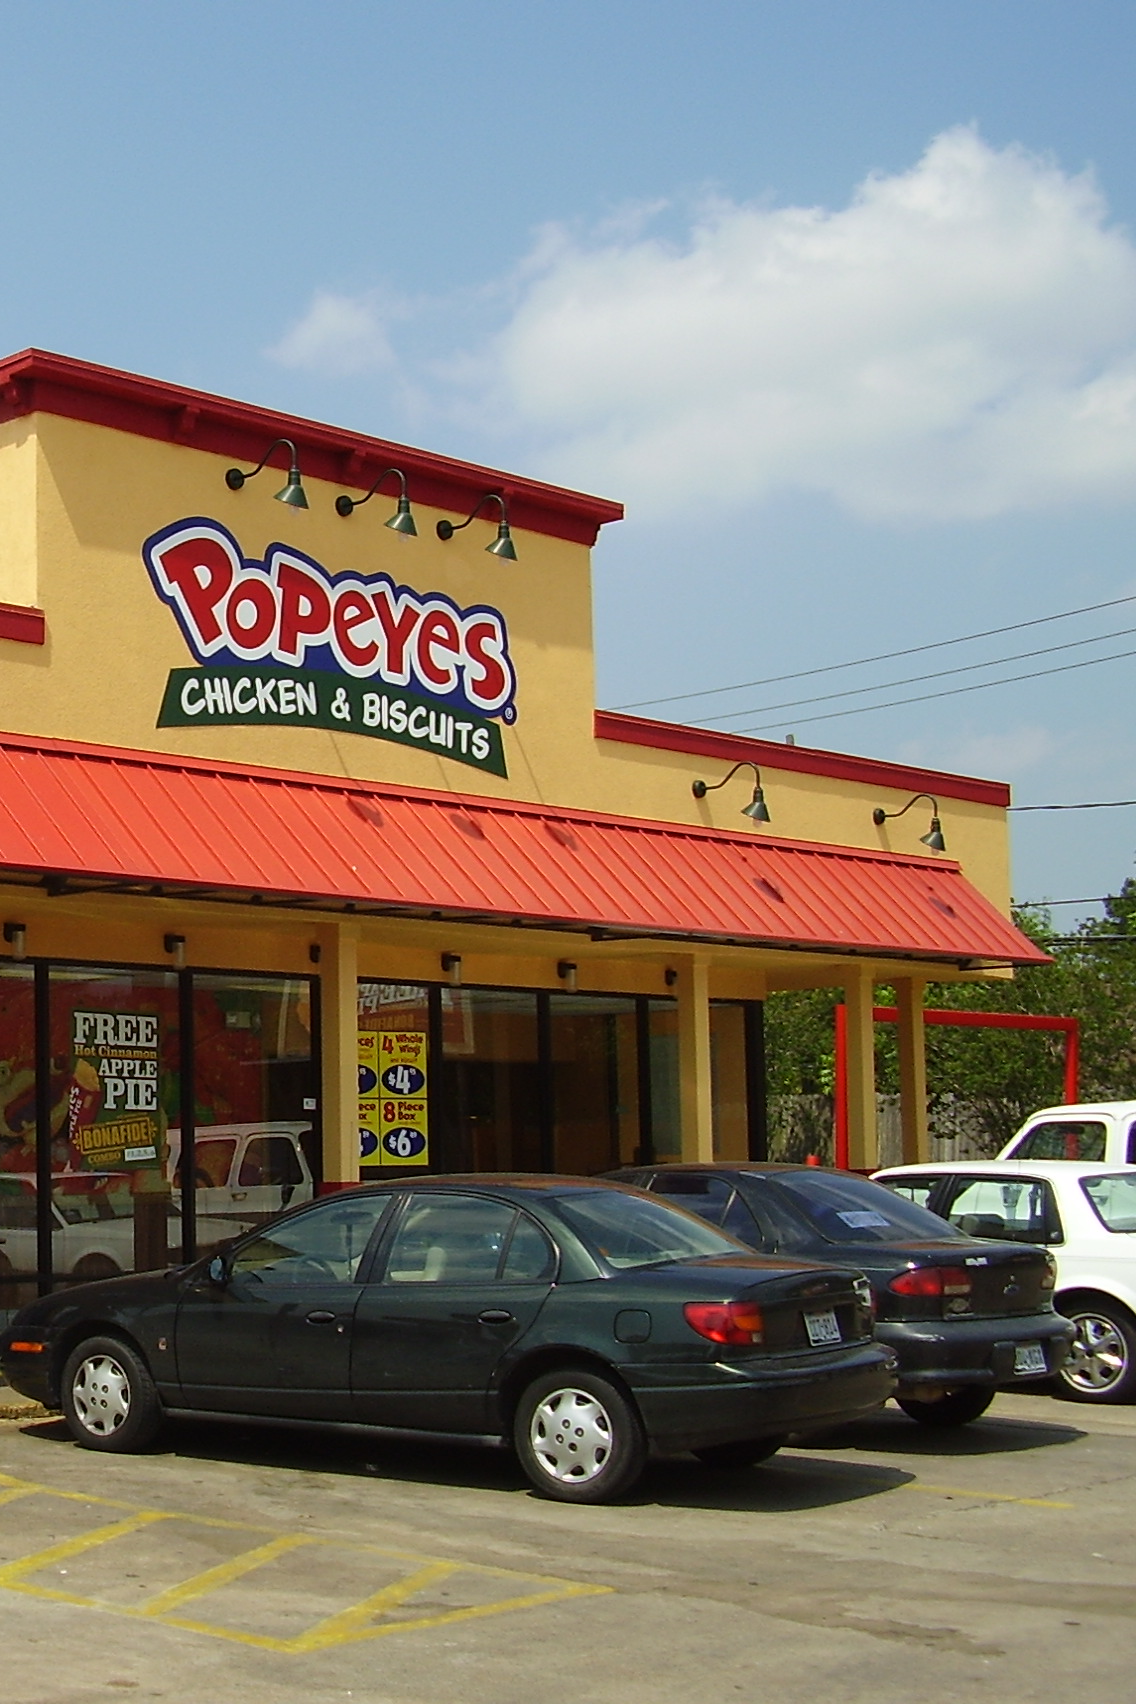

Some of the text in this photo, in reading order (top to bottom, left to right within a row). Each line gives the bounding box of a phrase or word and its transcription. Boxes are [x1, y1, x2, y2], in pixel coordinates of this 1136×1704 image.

[180, 677, 490, 760] CHICKEN & BISCUITS
[73, 1011, 158, 1048] FREE
[74, 1044, 158, 1060] Hot Cinnamon
[382, 1035, 394, 1055] 4
[98, 1058, 157, 1078] APPLE
[104, 1077, 157, 1111] PIE
[384, 1101, 424, 1122] 8 Piece
[398, 1112, 416, 1120] Box
[83, 1121, 149, 1150] BONAFIDE
